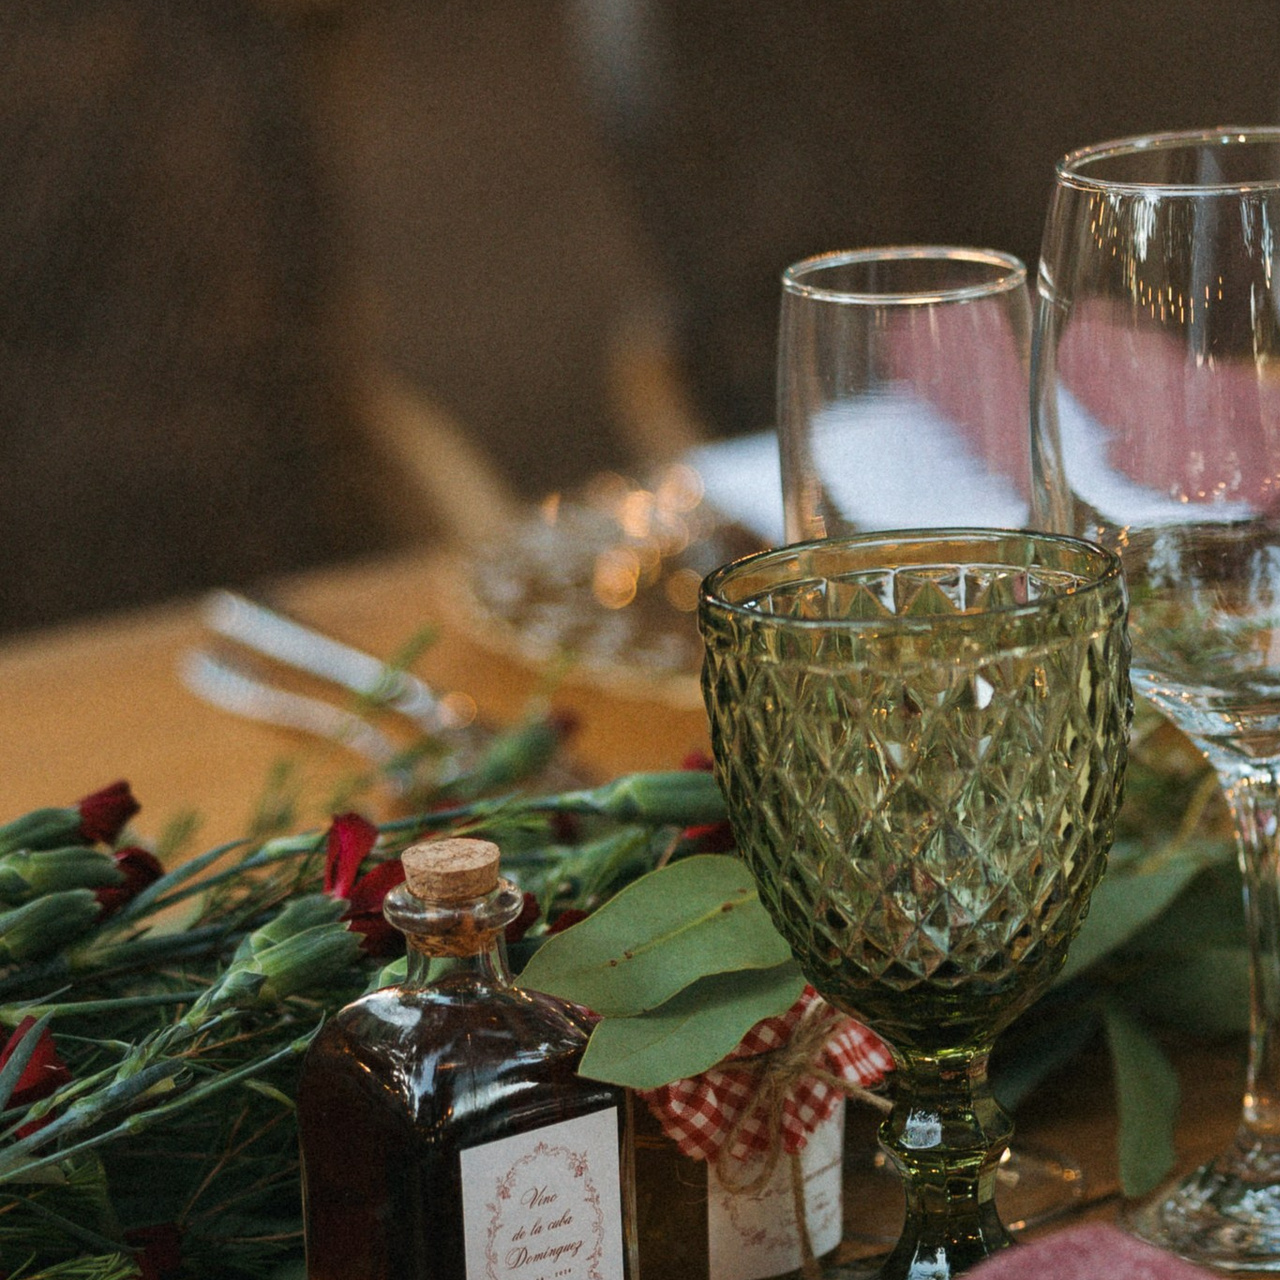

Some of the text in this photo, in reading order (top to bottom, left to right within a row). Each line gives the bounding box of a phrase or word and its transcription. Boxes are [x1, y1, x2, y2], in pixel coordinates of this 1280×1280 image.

[520, 1185, 559, 1209] Vino
[511, 1208, 574, 1242] de la cuba
